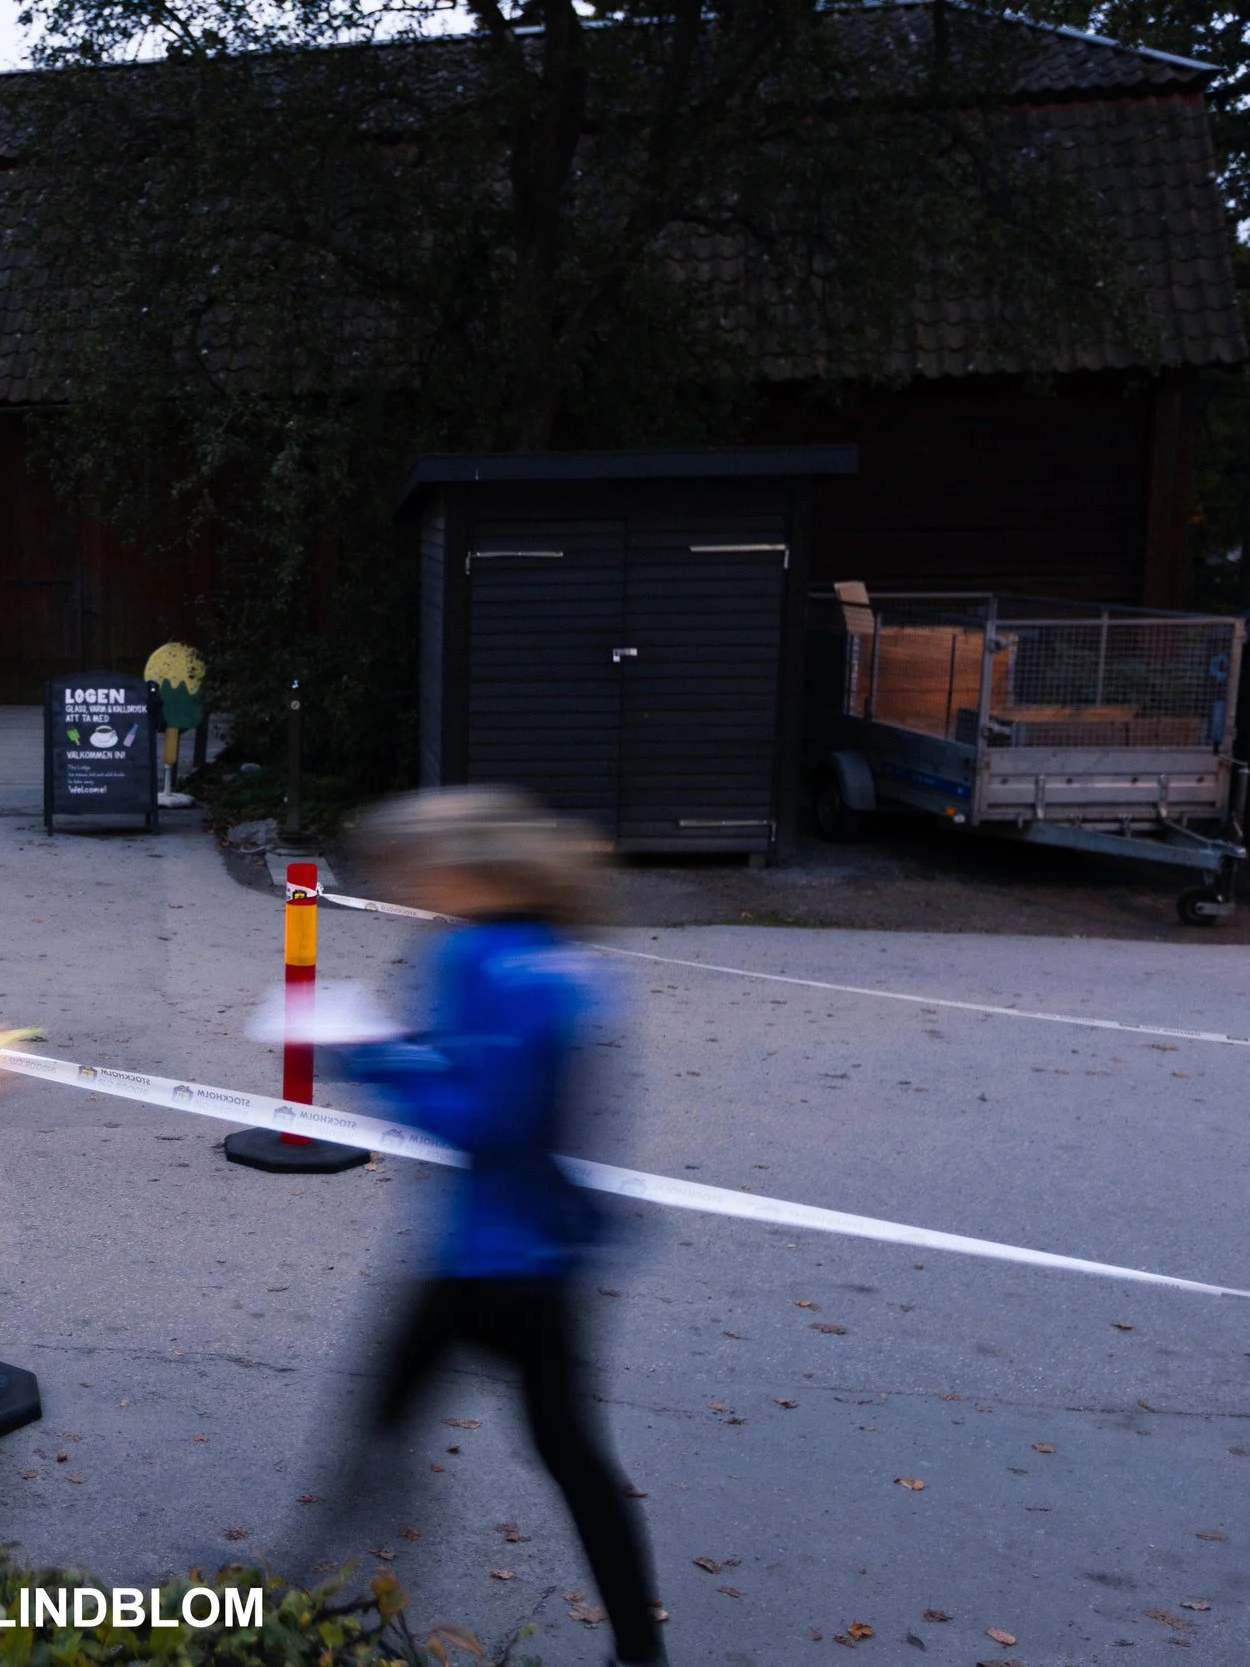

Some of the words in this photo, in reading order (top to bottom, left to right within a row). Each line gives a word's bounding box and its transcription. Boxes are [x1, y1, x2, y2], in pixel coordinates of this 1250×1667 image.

[65, 688, 125, 704] LOGEN
[66, 714, 79, 722] ATT
[82, 714, 91, 722] TA
[93, 714, 110, 723] MED
[68, 785, 107, 793] Welcome!
